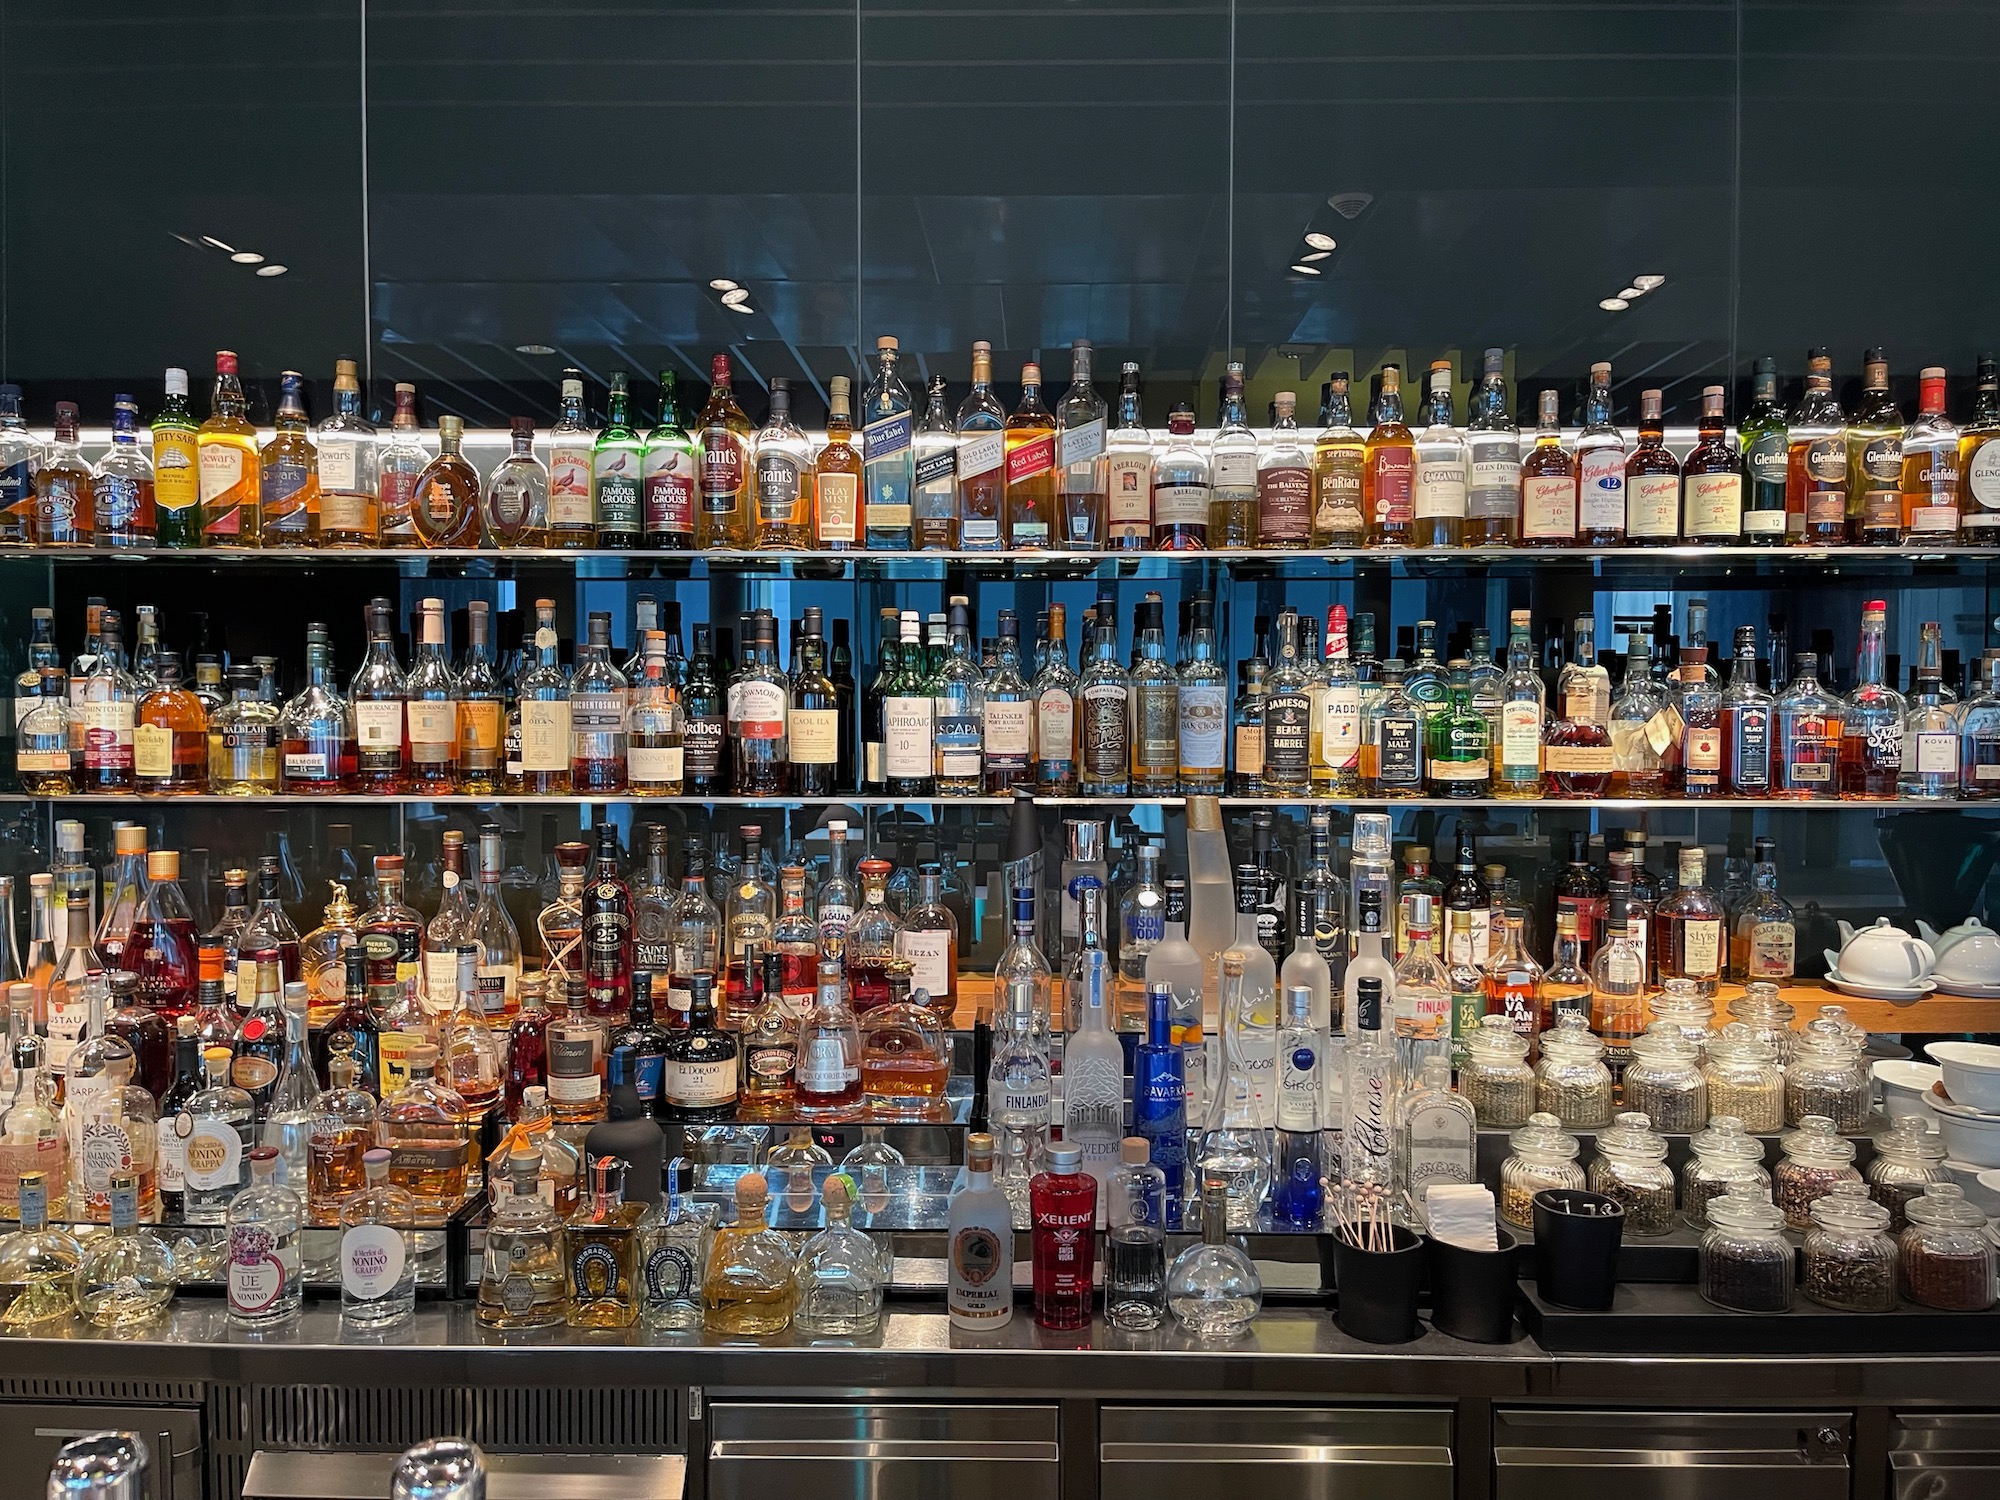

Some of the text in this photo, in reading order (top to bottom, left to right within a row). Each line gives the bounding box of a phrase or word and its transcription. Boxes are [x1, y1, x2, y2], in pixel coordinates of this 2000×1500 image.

[867, 425, 905, 447] Blue Label
[1063, 431, 1100, 449] PLATINUM
[320, 451, 351, 461] Dewar's
[1010, 448, 1049, 469] Red Label
[917, 456, 954, 475] BLACK LABEL
[1113, 460, 1147, 472] ABERLOUR
[1476, 463, 1494, 471] GLEN
[759, 469, 793, 484] Grant's
[1605, 479, 1618, 488] 12
[602, 486, 635, 496] FAMOUS
[654, 486, 687, 496] FAMOUS
[767, 486, 779, 496] 12
[824, 487, 849, 495] ISLAY
[104, 495, 114, 503] 18
[601, 495, 636, 505] GROUSE
[652, 495, 687, 504] GROUSE
[824, 495, 849, 504] MIST
[1884, 494, 1893, 502] 18
[612, 512, 624, 520] 12
[664, 511, 675, 520] 18
[1076, 523, 1085, 531] 18
[1088, 687, 1111, 697] COMPASS
[1268, 699, 1308, 710] JAMESON
[793, 716, 829, 726] CAOL ILA
[988, 712, 1023, 720] TALISKER
[222, 726, 268, 735] BALBLAIR
[939, 722, 977, 735] SCAPA
[1276, 726, 1302, 735] BLACK
[1385, 721, 1413, 730] Tullamore
[534, 730, 547, 745] 14
[1392, 728, 1406, 737] Dew
[900, 740, 909, 750] 10
[1274, 739, 1304, 748] BARREL
[1387, 740, 1411, 748] MALT
[288, 757, 322, 765] DALMORE
[597, 927, 617, 942] 25
[742, 927, 755, 936] 25
[908, 949, 940, 957] MEZAN
[638, 954, 667, 965] JAMES
[825, 991, 834, 1000] 30
[1505, 992, 1524, 1002] KA
[801, 997, 810, 1006] 8
[1505, 1001, 1524, 1011] VA
[1460, 1004, 1475, 1012] KA
[1557, 1007, 1582, 1016] KING
[50, 1015, 82, 1024] USTAU
[1460, 1011, 1475, 1020] VA
[1460, 1019, 1481, 1029] LAN
[679, 1066, 719, 1075] EL DORADO
[693, 1075, 703, 1083] 21
[1006, 1095, 1049, 1109] FINLANDIA
[1354, 1077, 1389, 1157] Chase
[188, 1149, 225, 1160] NONINO
[190, 1158, 222, 1168] GRAPPA
[392, 1154, 435, 1166] Amarone
[201, 1197, 213, 1205] 100
[1039, 1211, 1092, 1225] XELLENT
[577, 1246, 615, 1265] HERRADURA
[650, 1248, 687, 1268] HERRADURA
[352, 1255, 388, 1267] NONINO
[355, 1266, 383, 1275] GRAPPA
[241, 1275, 259, 1287] UE
[236, 1292, 267, 1302] NONINO
[956, 1289, 998, 1298] IMPERIAL
